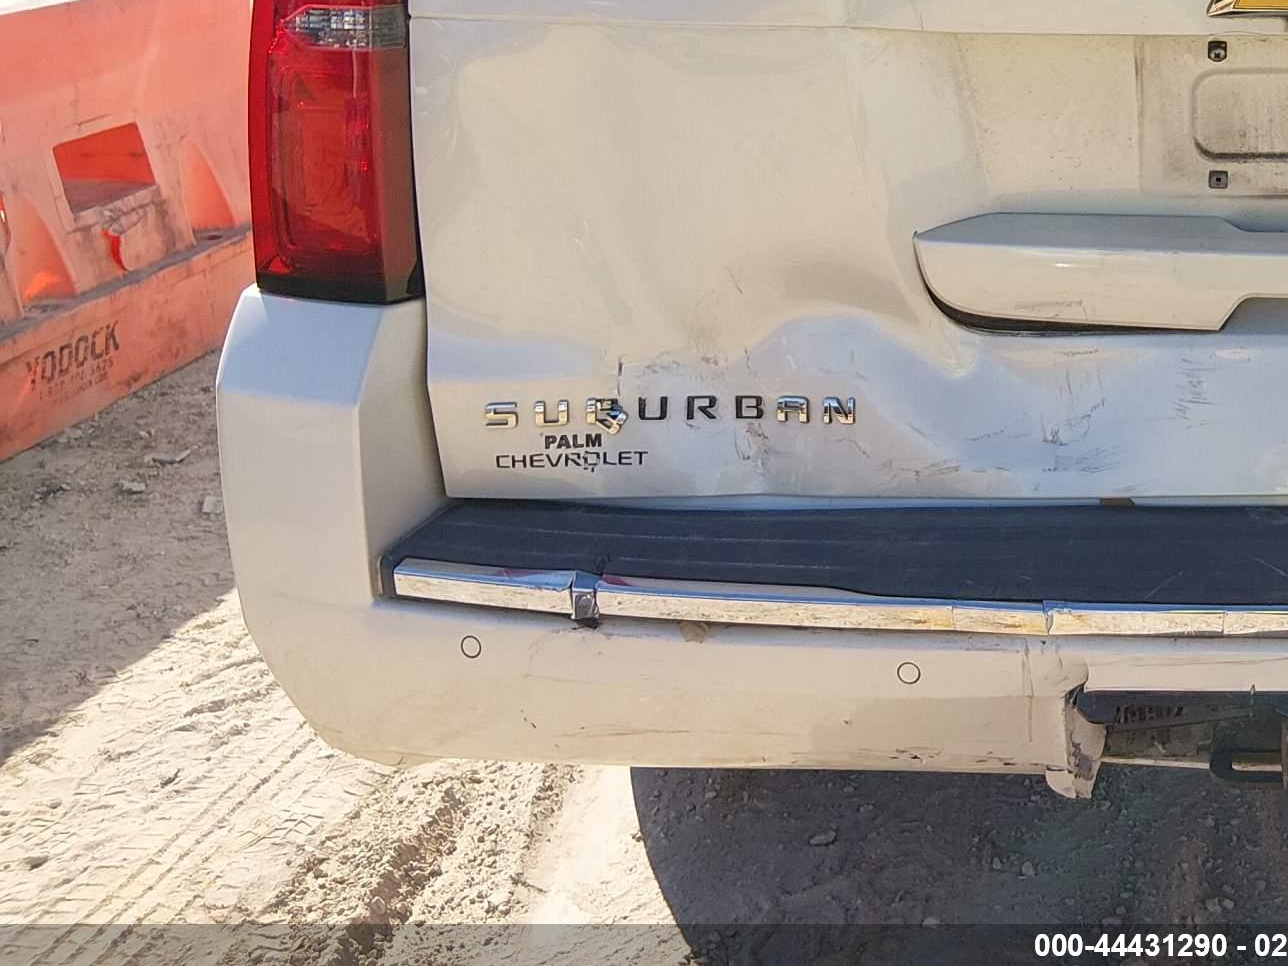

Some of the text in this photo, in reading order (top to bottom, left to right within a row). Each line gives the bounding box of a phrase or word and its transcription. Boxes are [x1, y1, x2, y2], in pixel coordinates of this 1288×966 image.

[26, 320, 120, 391] YODOCK
[484, 394, 857, 434] SUBURBAN
[544, 433, 603, 450] PALM
[495, 450, 649, 471] CHEVROLET
